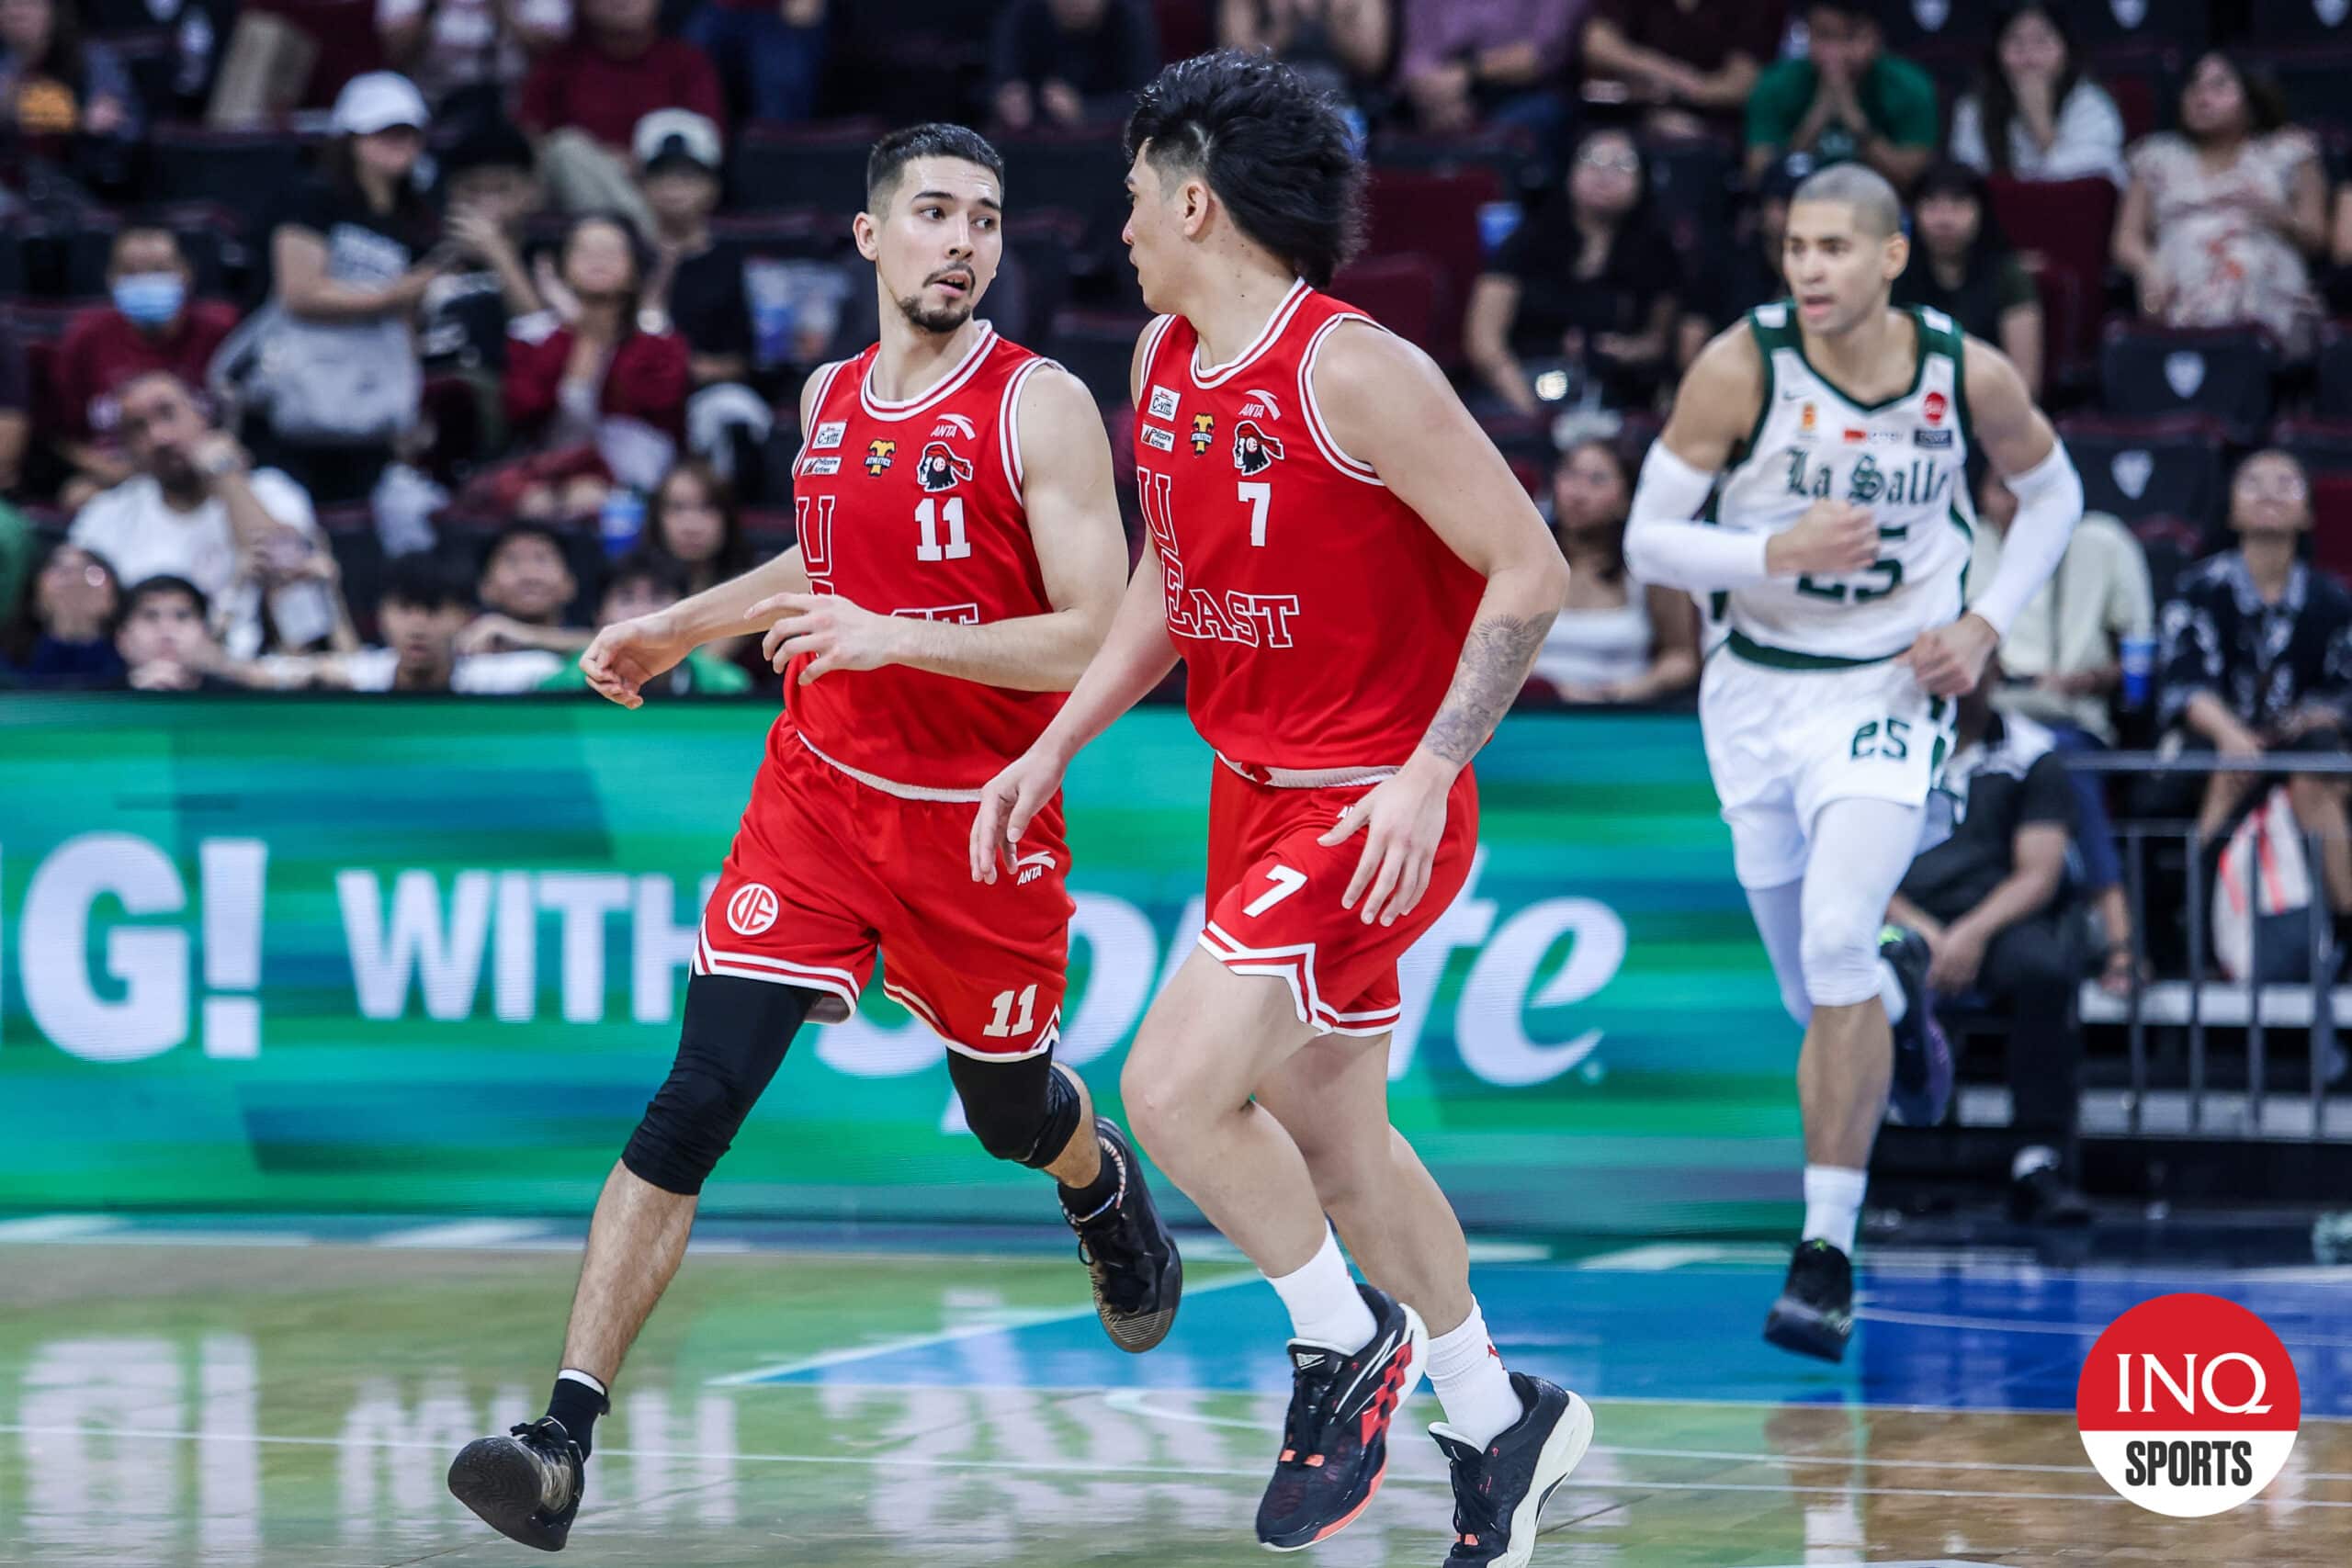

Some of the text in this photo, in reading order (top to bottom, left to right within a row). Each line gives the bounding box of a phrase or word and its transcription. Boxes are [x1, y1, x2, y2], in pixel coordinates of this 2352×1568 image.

[931, 424, 957, 438] ANTA
[1238, 402, 1265, 419] ANTA
[1787, 446, 1833, 500] La
[914, 497, 971, 561] 11
[1238, 481, 1272, 547] 7
[1161, 548, 1300, 649] EAST
[1851, 718, 1911, 759] 25
[1016, 864, 1043, 886] ANTA
[1242, 863, 1308, 918] 7
[0, 830, 269, 1063] G!
[335, 869, 723, 1024] WITH
[983, 984, 1038, 1038] 11
